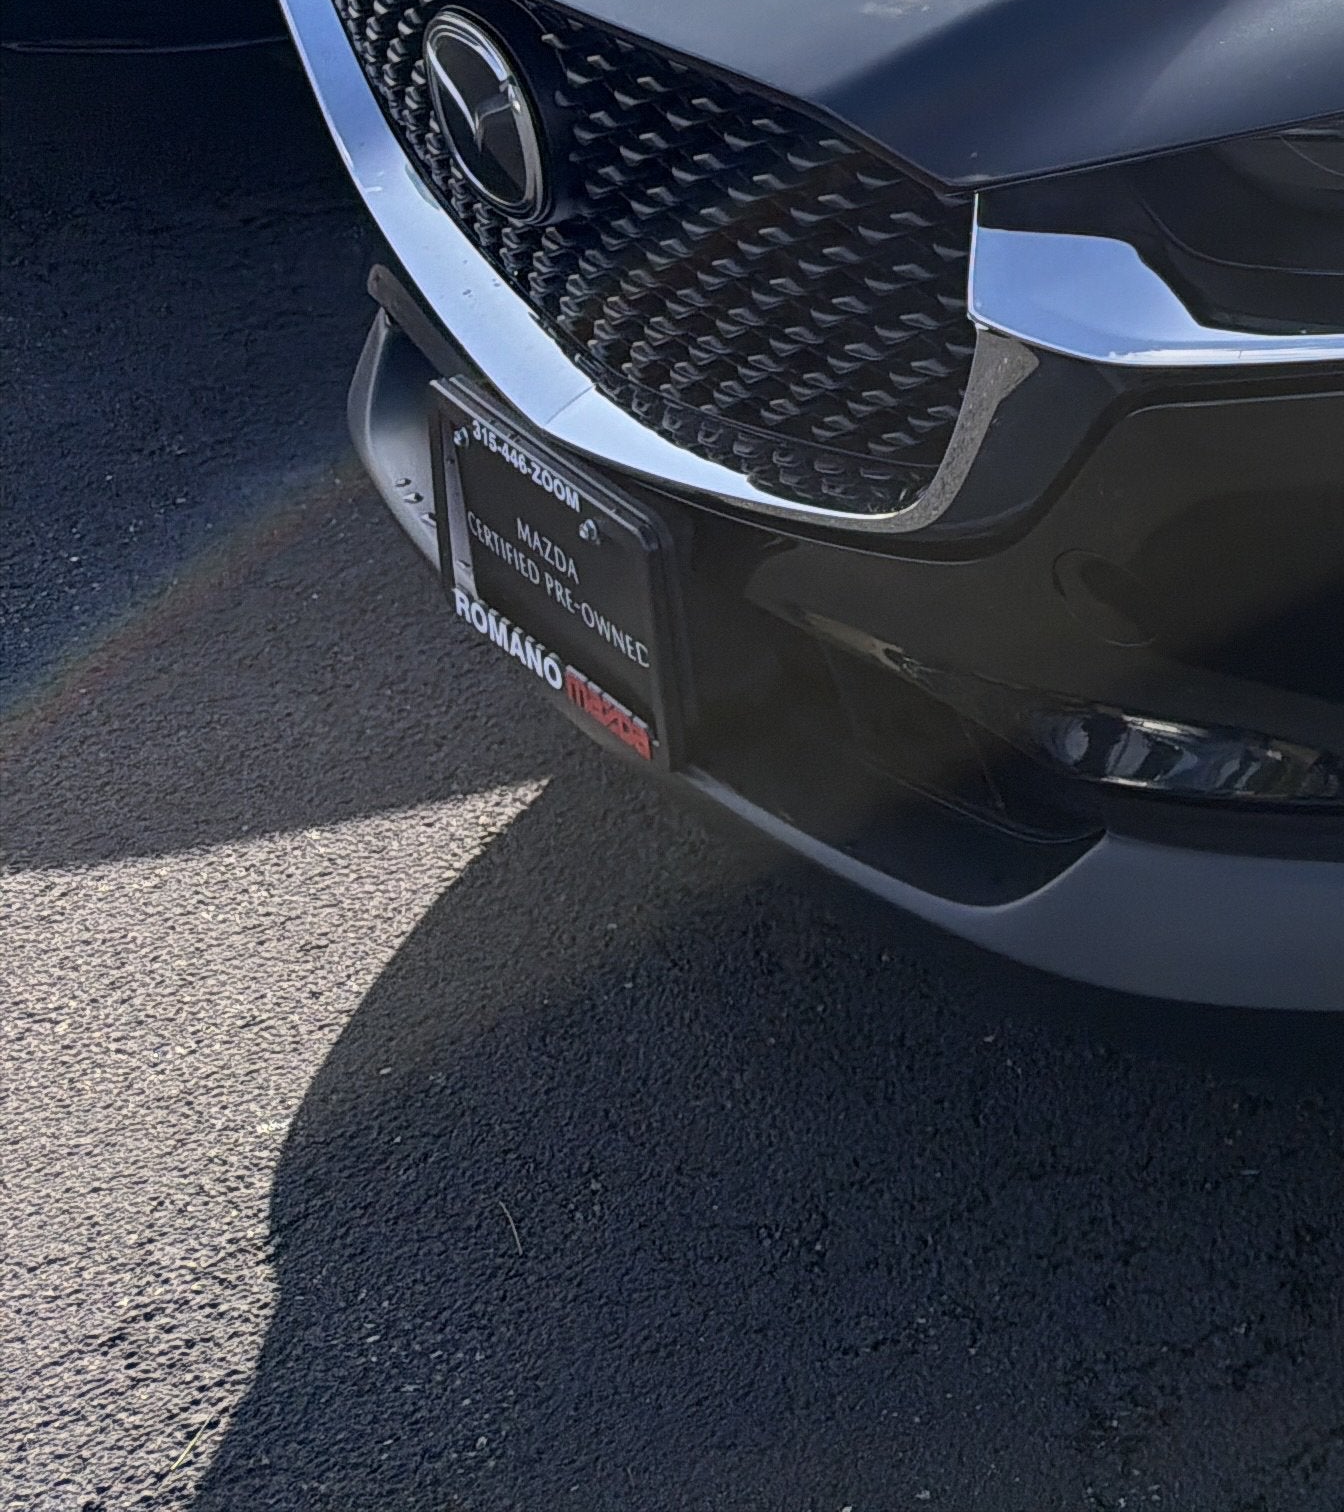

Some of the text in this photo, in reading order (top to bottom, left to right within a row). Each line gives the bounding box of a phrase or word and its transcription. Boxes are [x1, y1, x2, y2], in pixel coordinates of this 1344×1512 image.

[472, 419, 581, 513] 315-446-ZOOM
[467, 510, 540, 585] CERTIFIED
[516, 517, 580, 585] MAZDA
[454, 588, 563, 689] ROMANO
